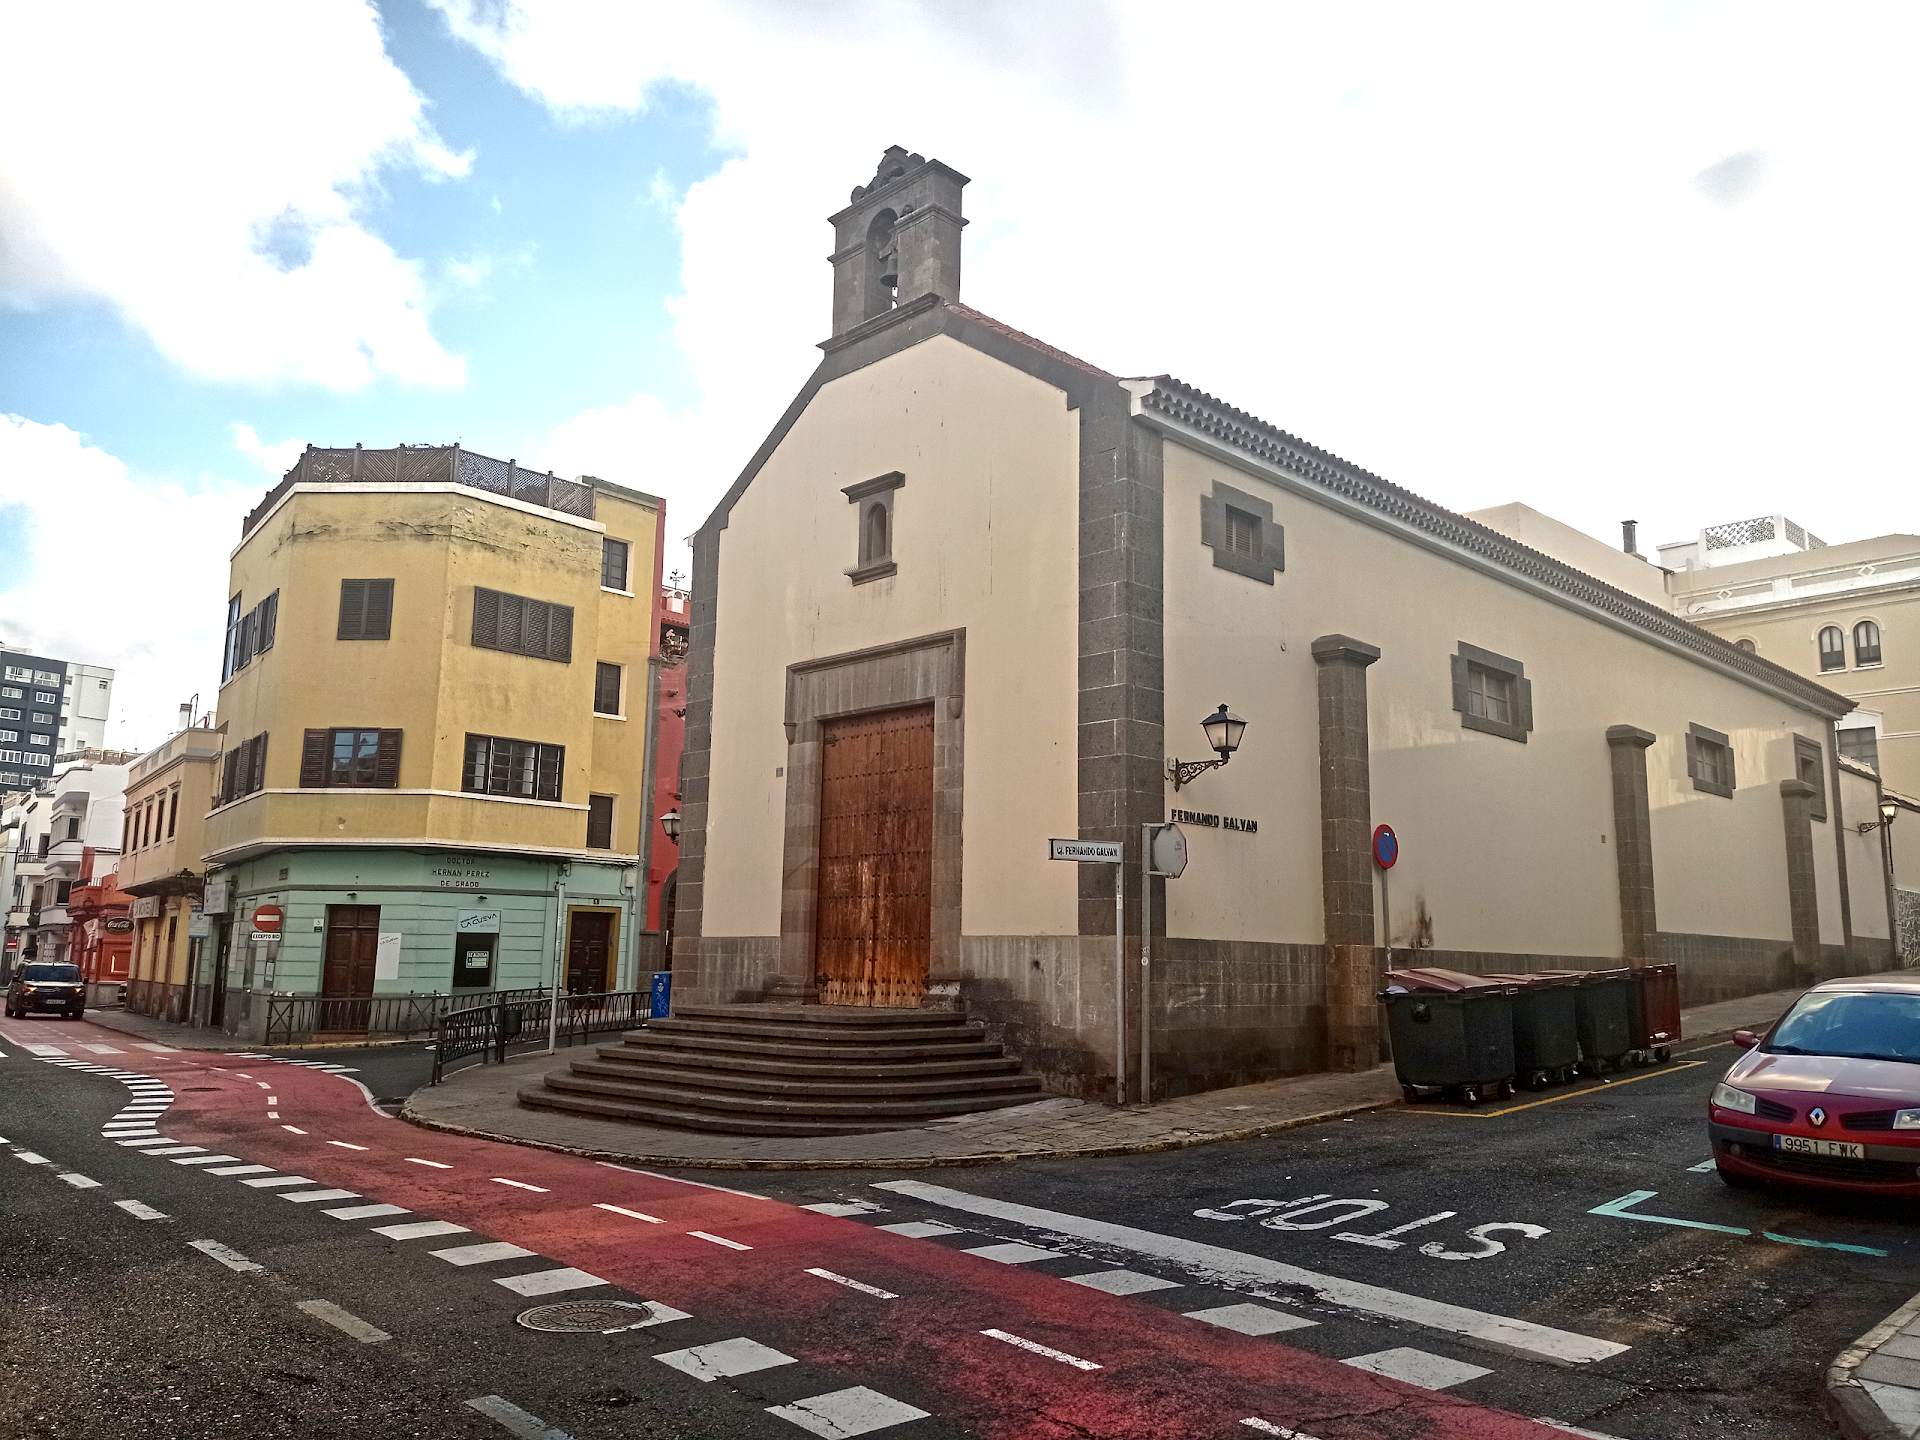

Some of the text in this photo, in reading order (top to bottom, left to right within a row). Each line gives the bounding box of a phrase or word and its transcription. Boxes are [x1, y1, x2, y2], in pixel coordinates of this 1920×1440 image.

[1171, 808, 1258, 833] FERNANDO GALVAN
[1065, 846, 1095, 856] FERNANDO
[1096, 847, 1118, 857] GALVAN
[446, 857, 475, 865] DOCTOR
[432, 868, 490, 878] HERNAN PEREZ
[1785, 1137, 1859, 1158] 9951 FWK
[1192, 1193, 1552, 1261] STOP
